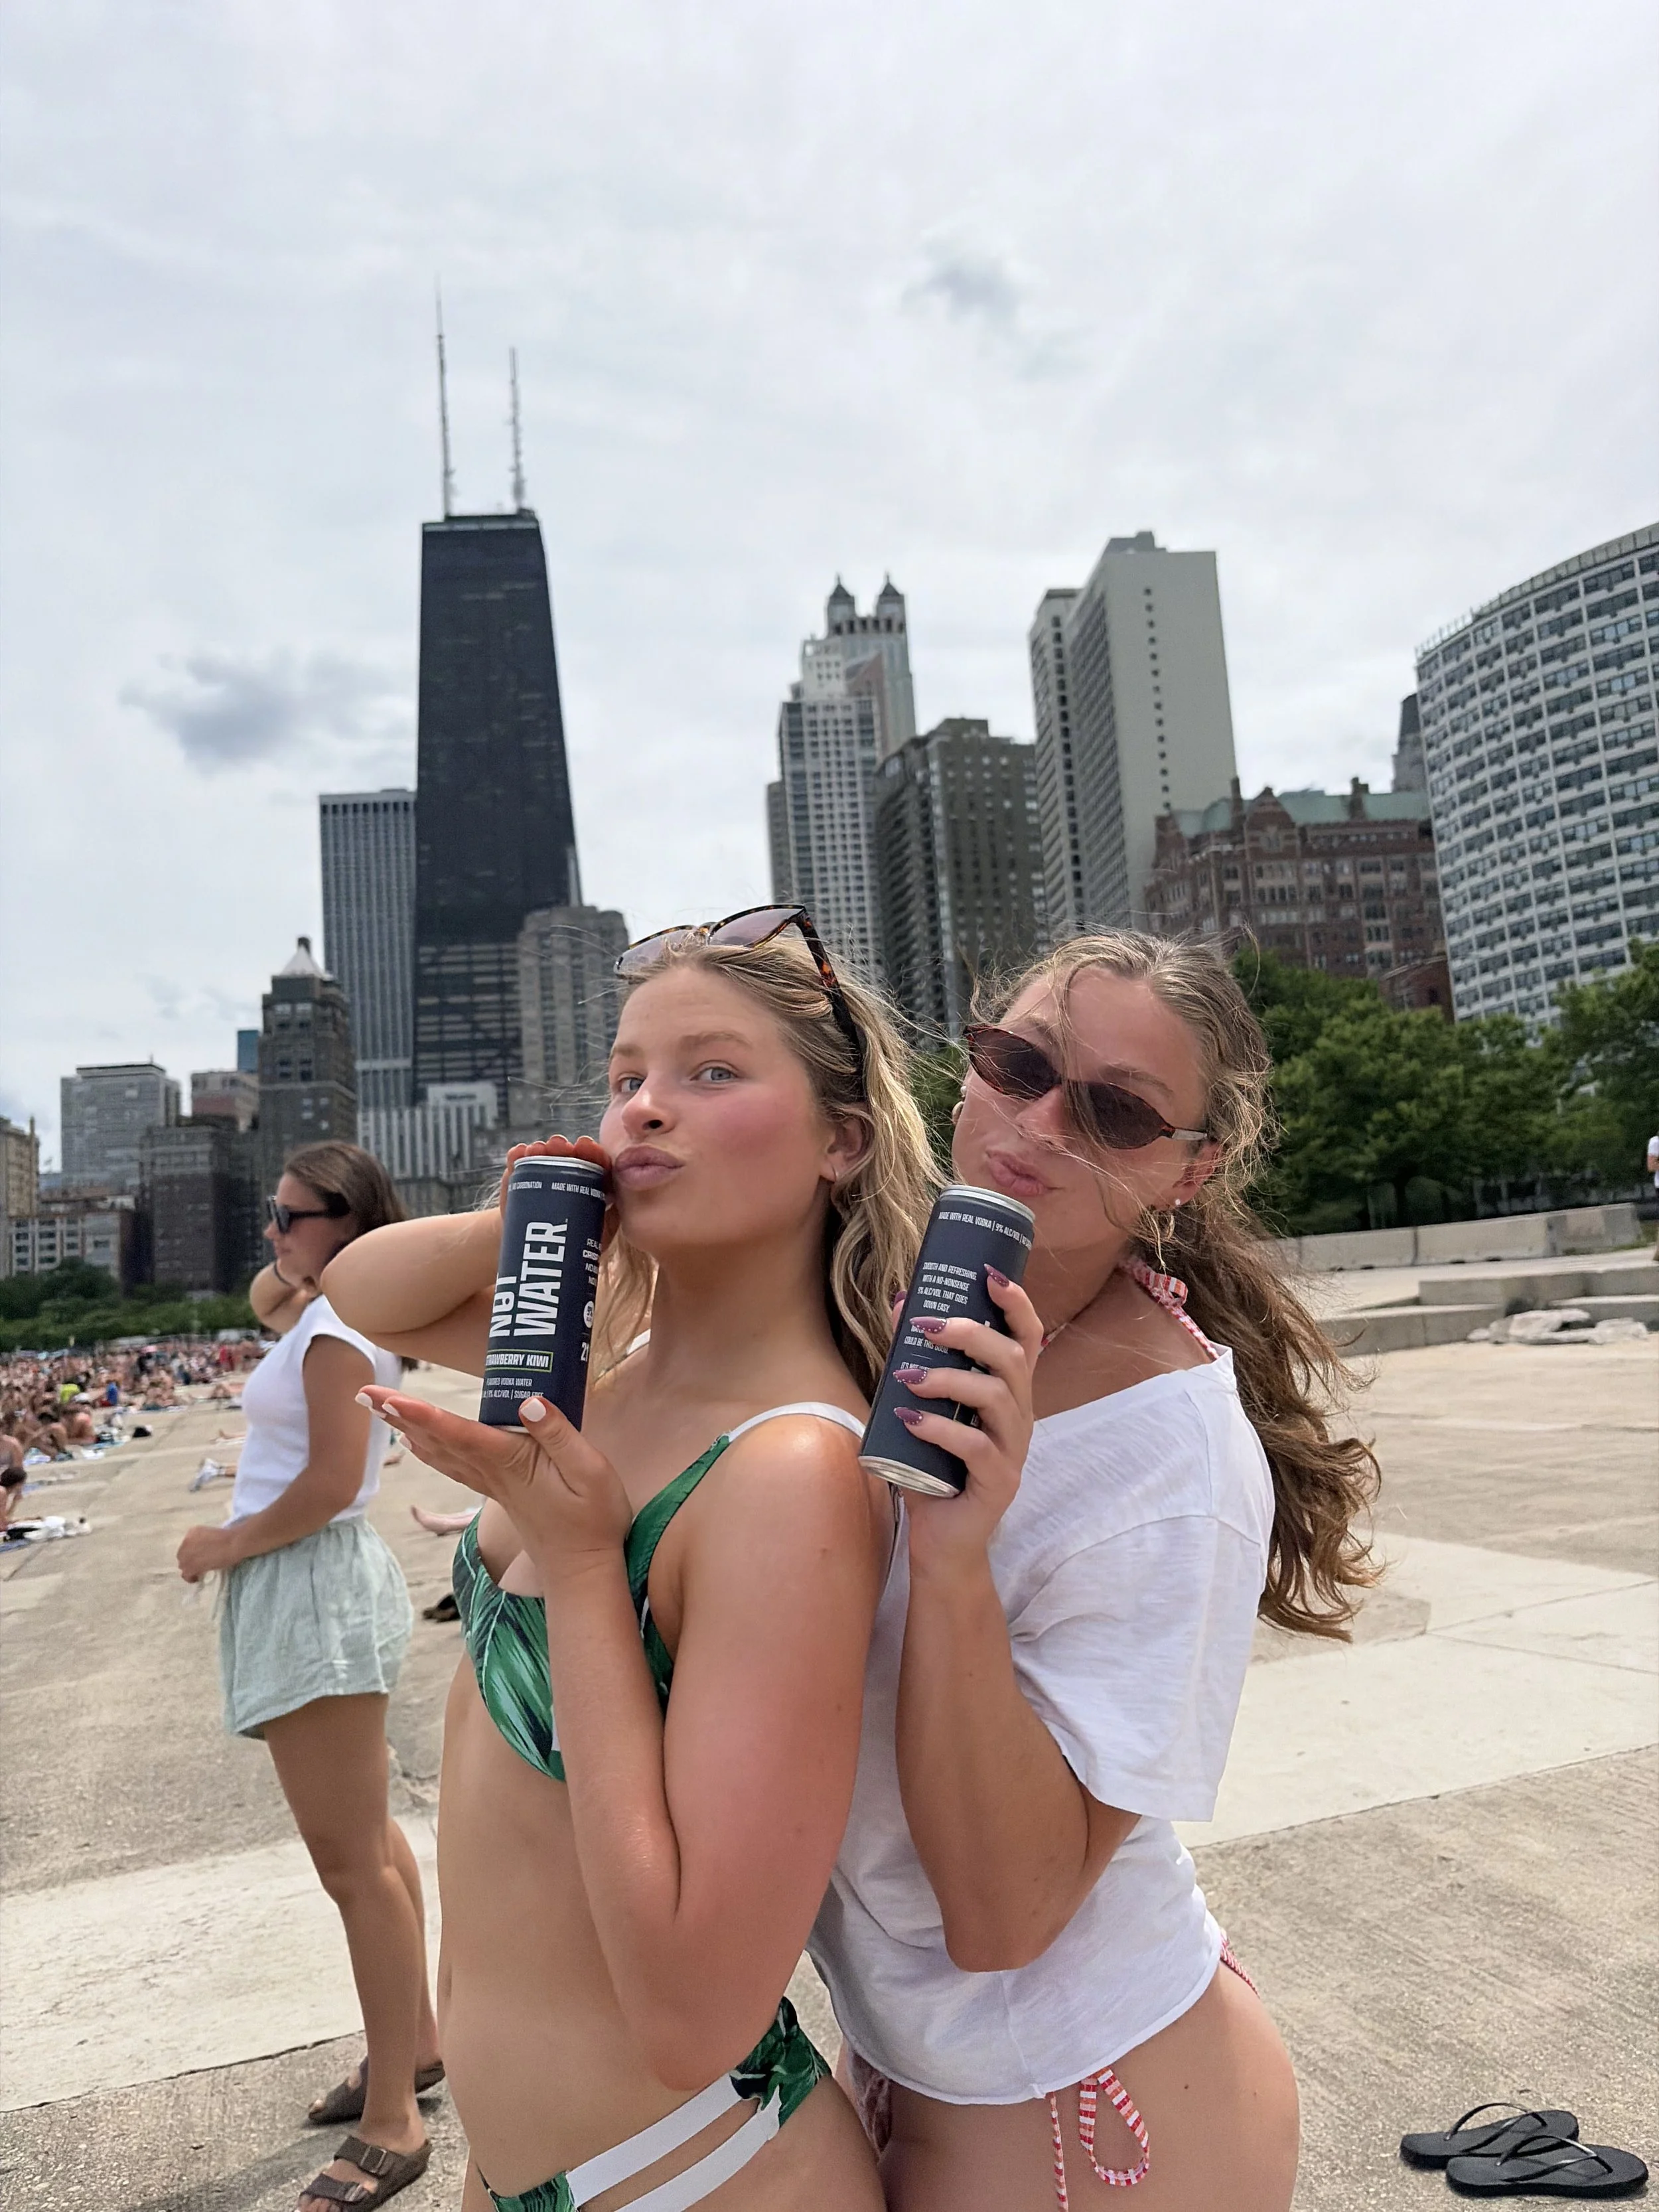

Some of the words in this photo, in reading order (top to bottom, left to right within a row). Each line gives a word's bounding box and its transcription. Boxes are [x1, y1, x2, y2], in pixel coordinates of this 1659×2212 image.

[552, 1183, 566, 1191] MADE
[567, 1183, 579, 1193] WITH
[580, 1186, 590, 1195] REAL
[950, 1213, 962, 1221] WITH
[963, 1214, 974, 1224] REAL
[975, 1217, 991, 1229] VODKA
[996, 1224, 1004, 1234] 9%
[587, 1238, 598, 1250] REAL
[938, 1264, 948, 1272] AND
[514, 1222, 567, 1336] WATER
[936, 1277, 970, 1291] NO-NONSENSE
[924, 1288, 942, 1297] ALC/VOL
[942, 1290, 956, 1301] THAT
[955, 1293, 968, 1305] GOES
[489, 1272, 517, 1338] NOT
[923, 1300, 938, 1310] DOWN
[904, 1336, 917, 1345] COULD
[916, 1338, 924, 1347] BE
[924, 1340, 935, 1350] THIS
[526, 1355, 549, 1368] KIWI
[516, 1378, 533, 1387] WATER
[494, 1390, 510, 1399] ALC/VOL
[514, 1390, 531, 1399] SUGAR
